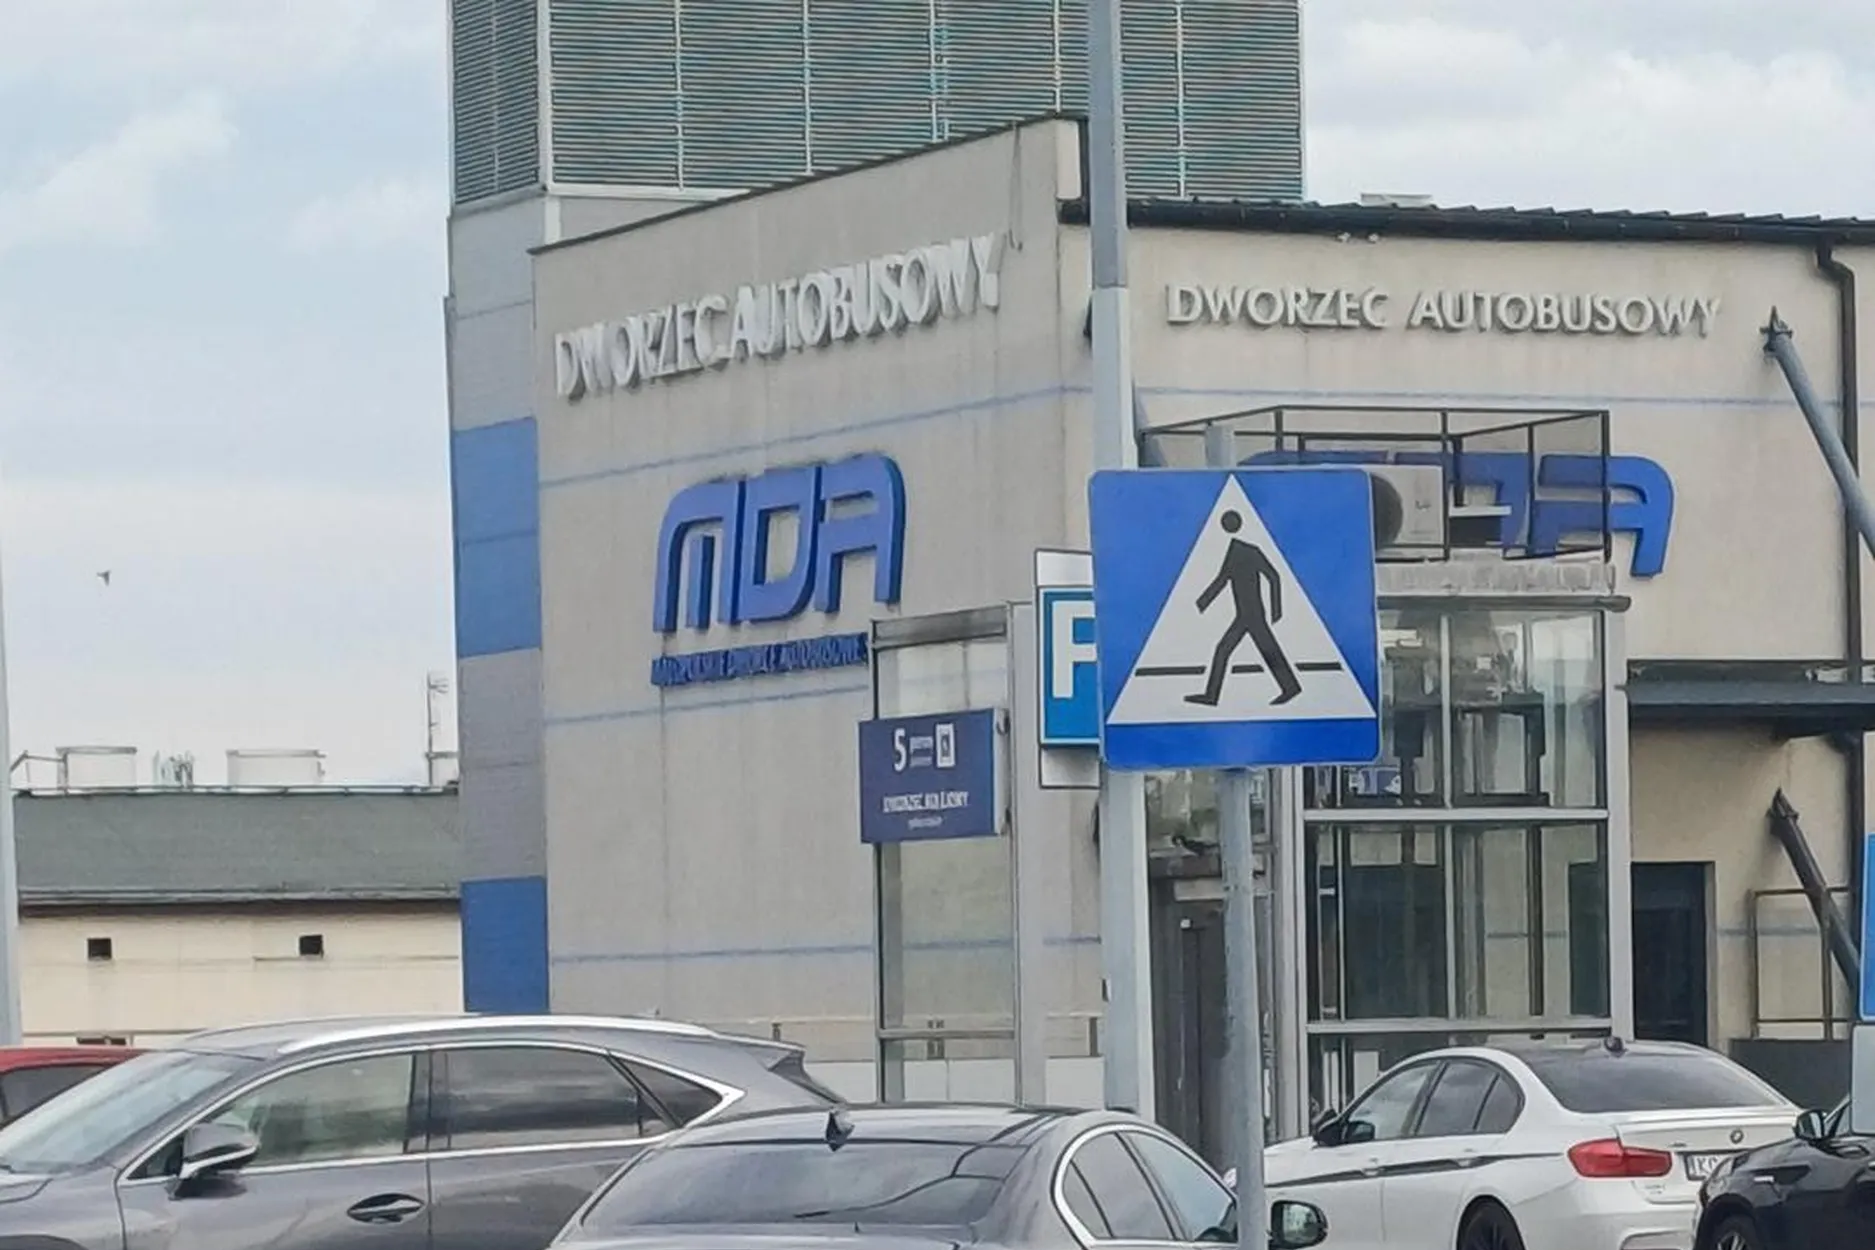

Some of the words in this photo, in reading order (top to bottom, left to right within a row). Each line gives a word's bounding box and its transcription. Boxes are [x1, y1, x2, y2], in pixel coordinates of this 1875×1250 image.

[555, 294, 730, 400] DWORZEC
[731, 234, 999, 359] AUTOBUSOWY
[1166, 284, 1389, 329] DWORZEC
[1408, 291, 1721, 338] AUTOBUSOWY
[653, 453, 905, 632] MDA
